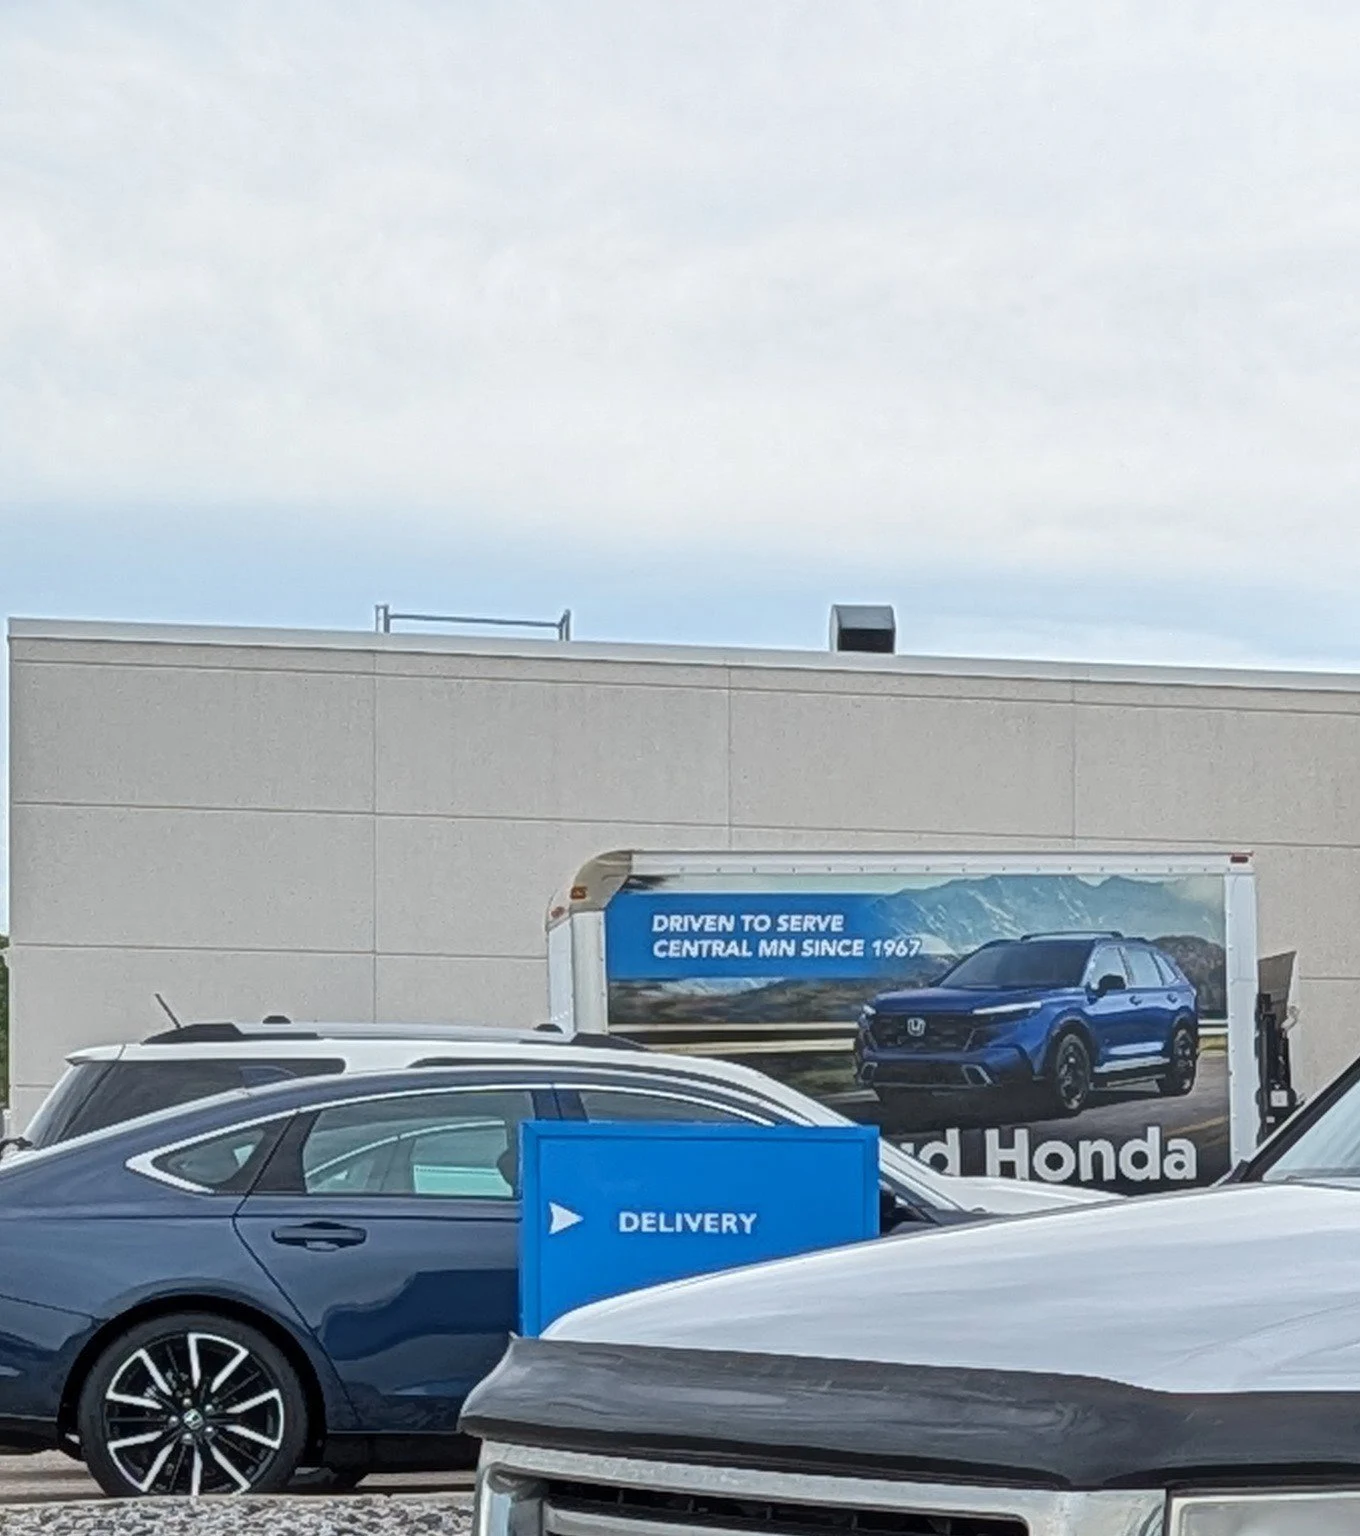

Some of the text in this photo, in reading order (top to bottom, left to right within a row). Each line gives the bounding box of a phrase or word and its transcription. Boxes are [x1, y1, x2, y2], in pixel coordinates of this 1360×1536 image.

[652, 914, 844, 932] DRIVEN TO SERVE
[653, 938, 921, 958] CENTRAL MN SINCE 1967
[984, 1126, 1197, 1182] Honda
[619, 1211, 757, 1234] DELIVERY
